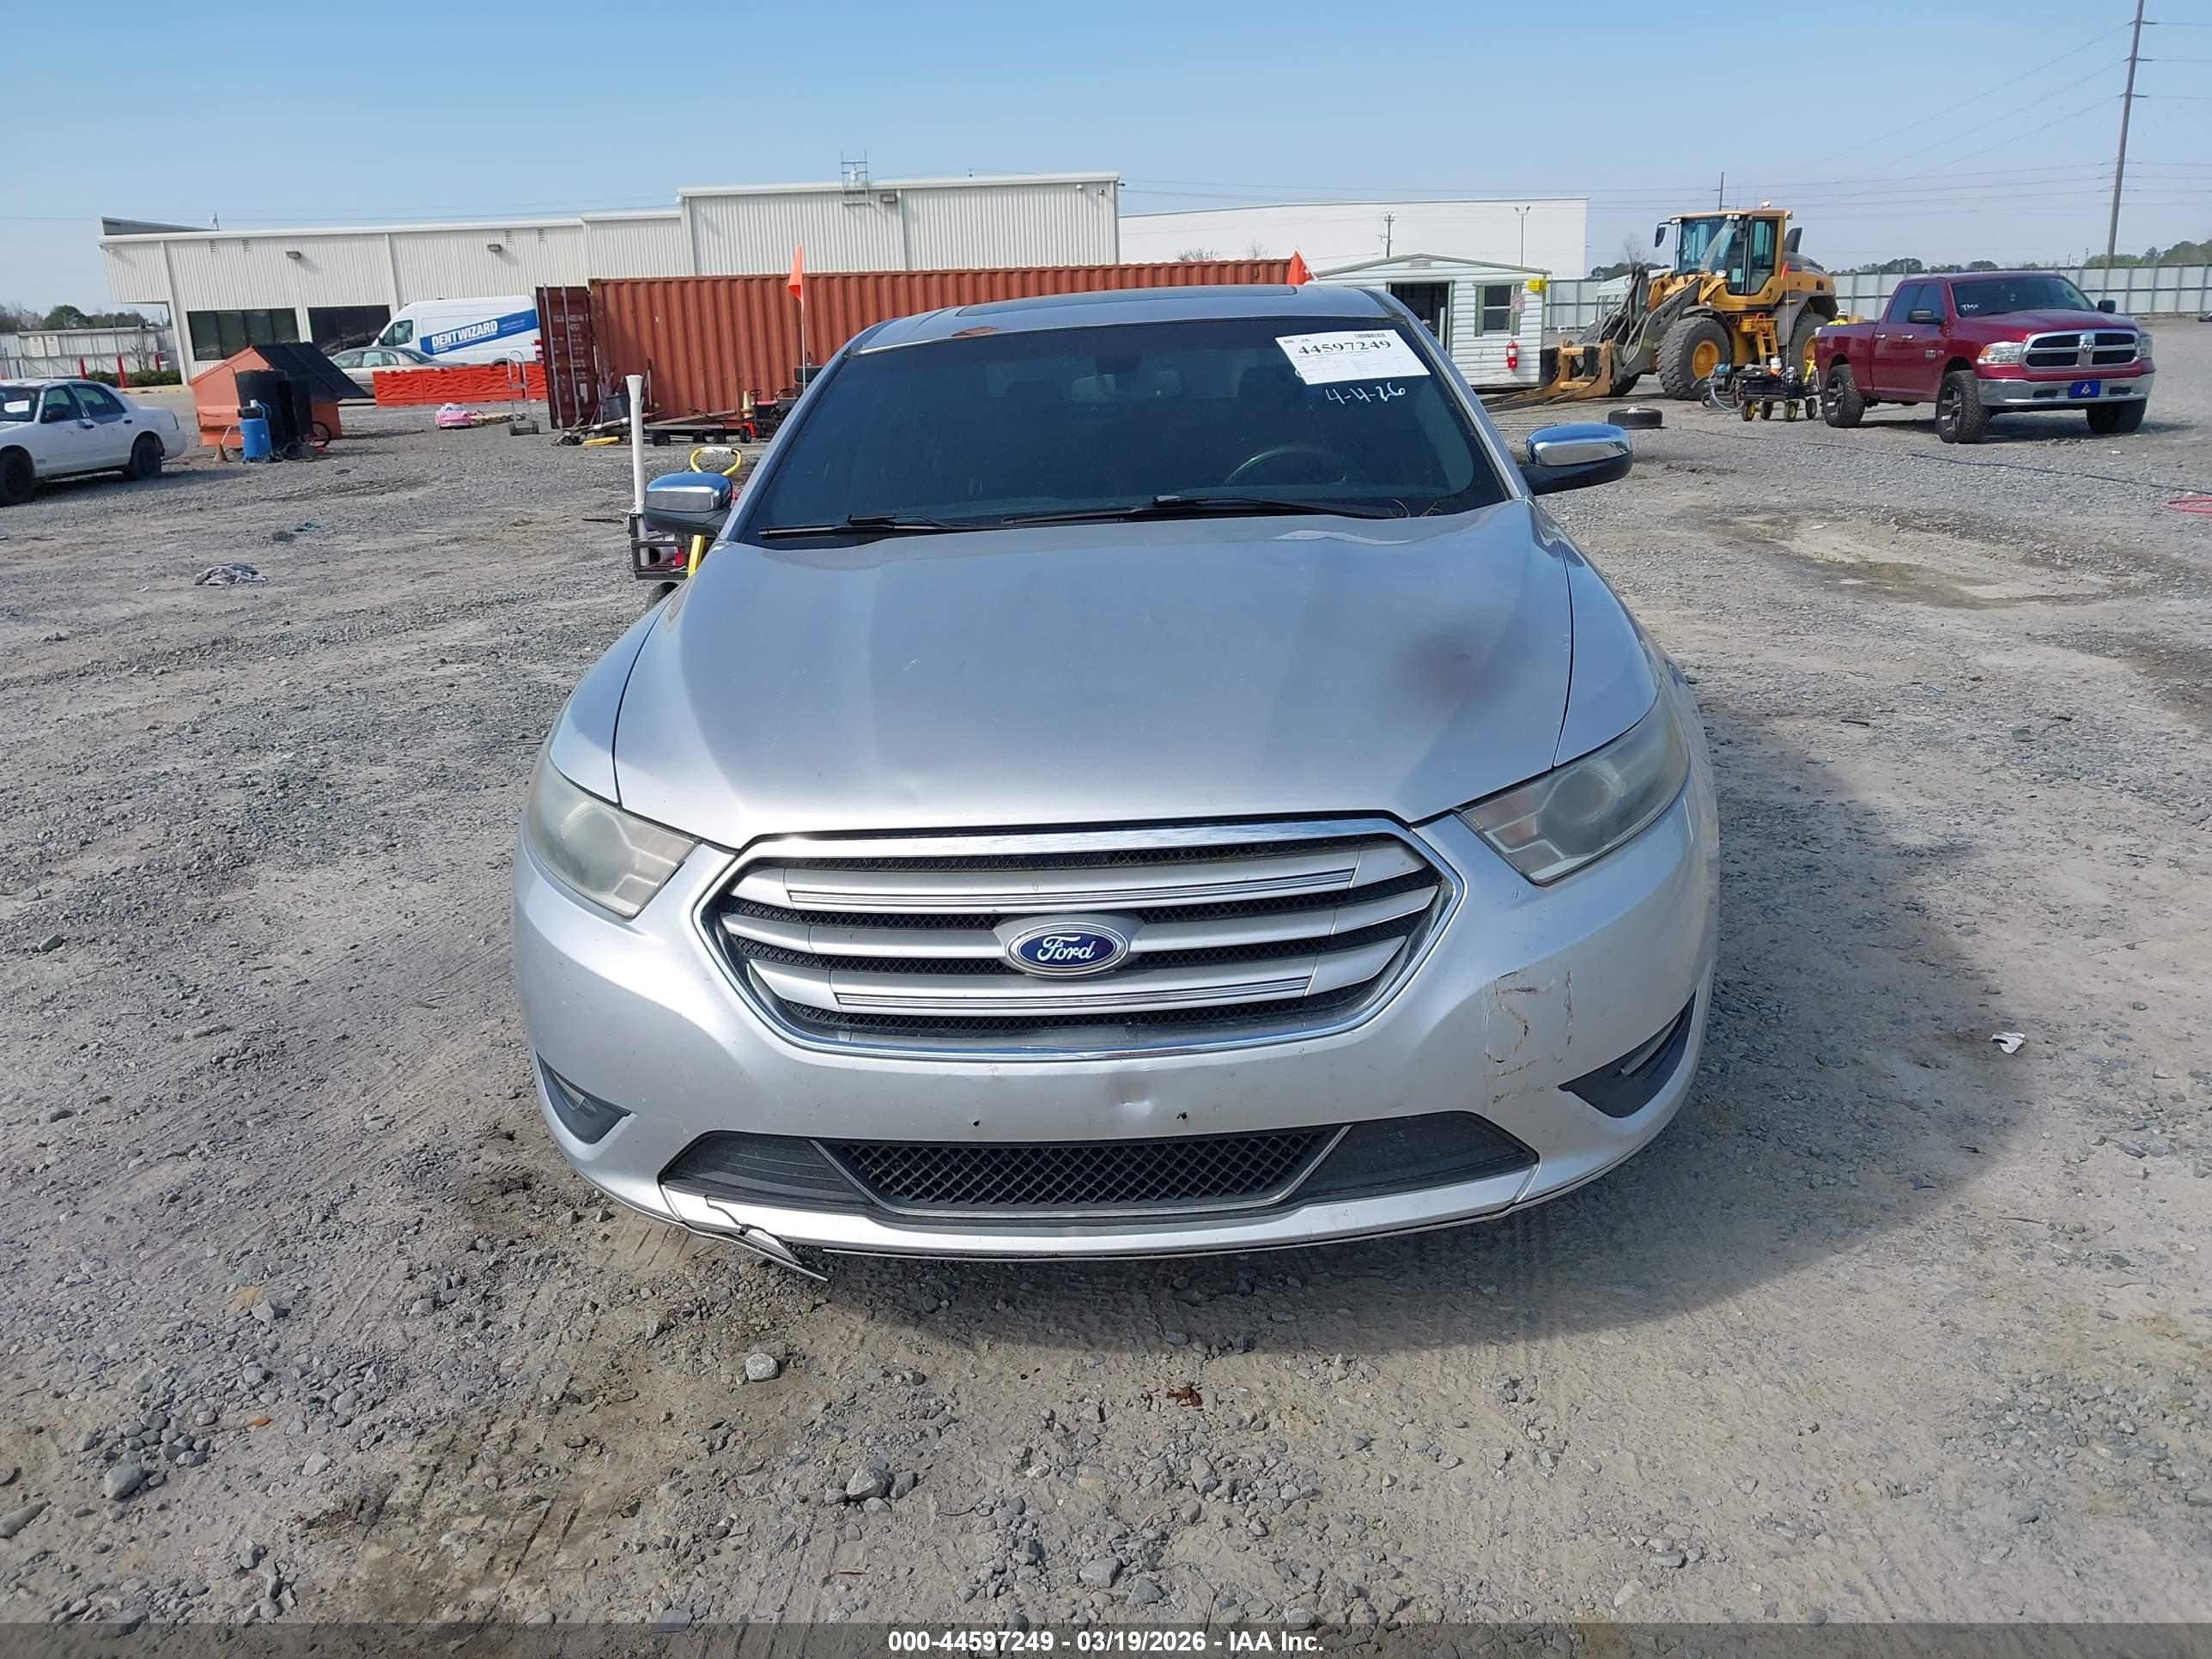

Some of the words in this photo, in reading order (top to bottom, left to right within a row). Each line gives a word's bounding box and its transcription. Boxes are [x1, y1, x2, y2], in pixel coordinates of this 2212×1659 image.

[1297, 340, 1391, 355] 44597249
[1325, 381, 1407, 404] 4-4-26
[1036, 935, 1097, 961] Ford
